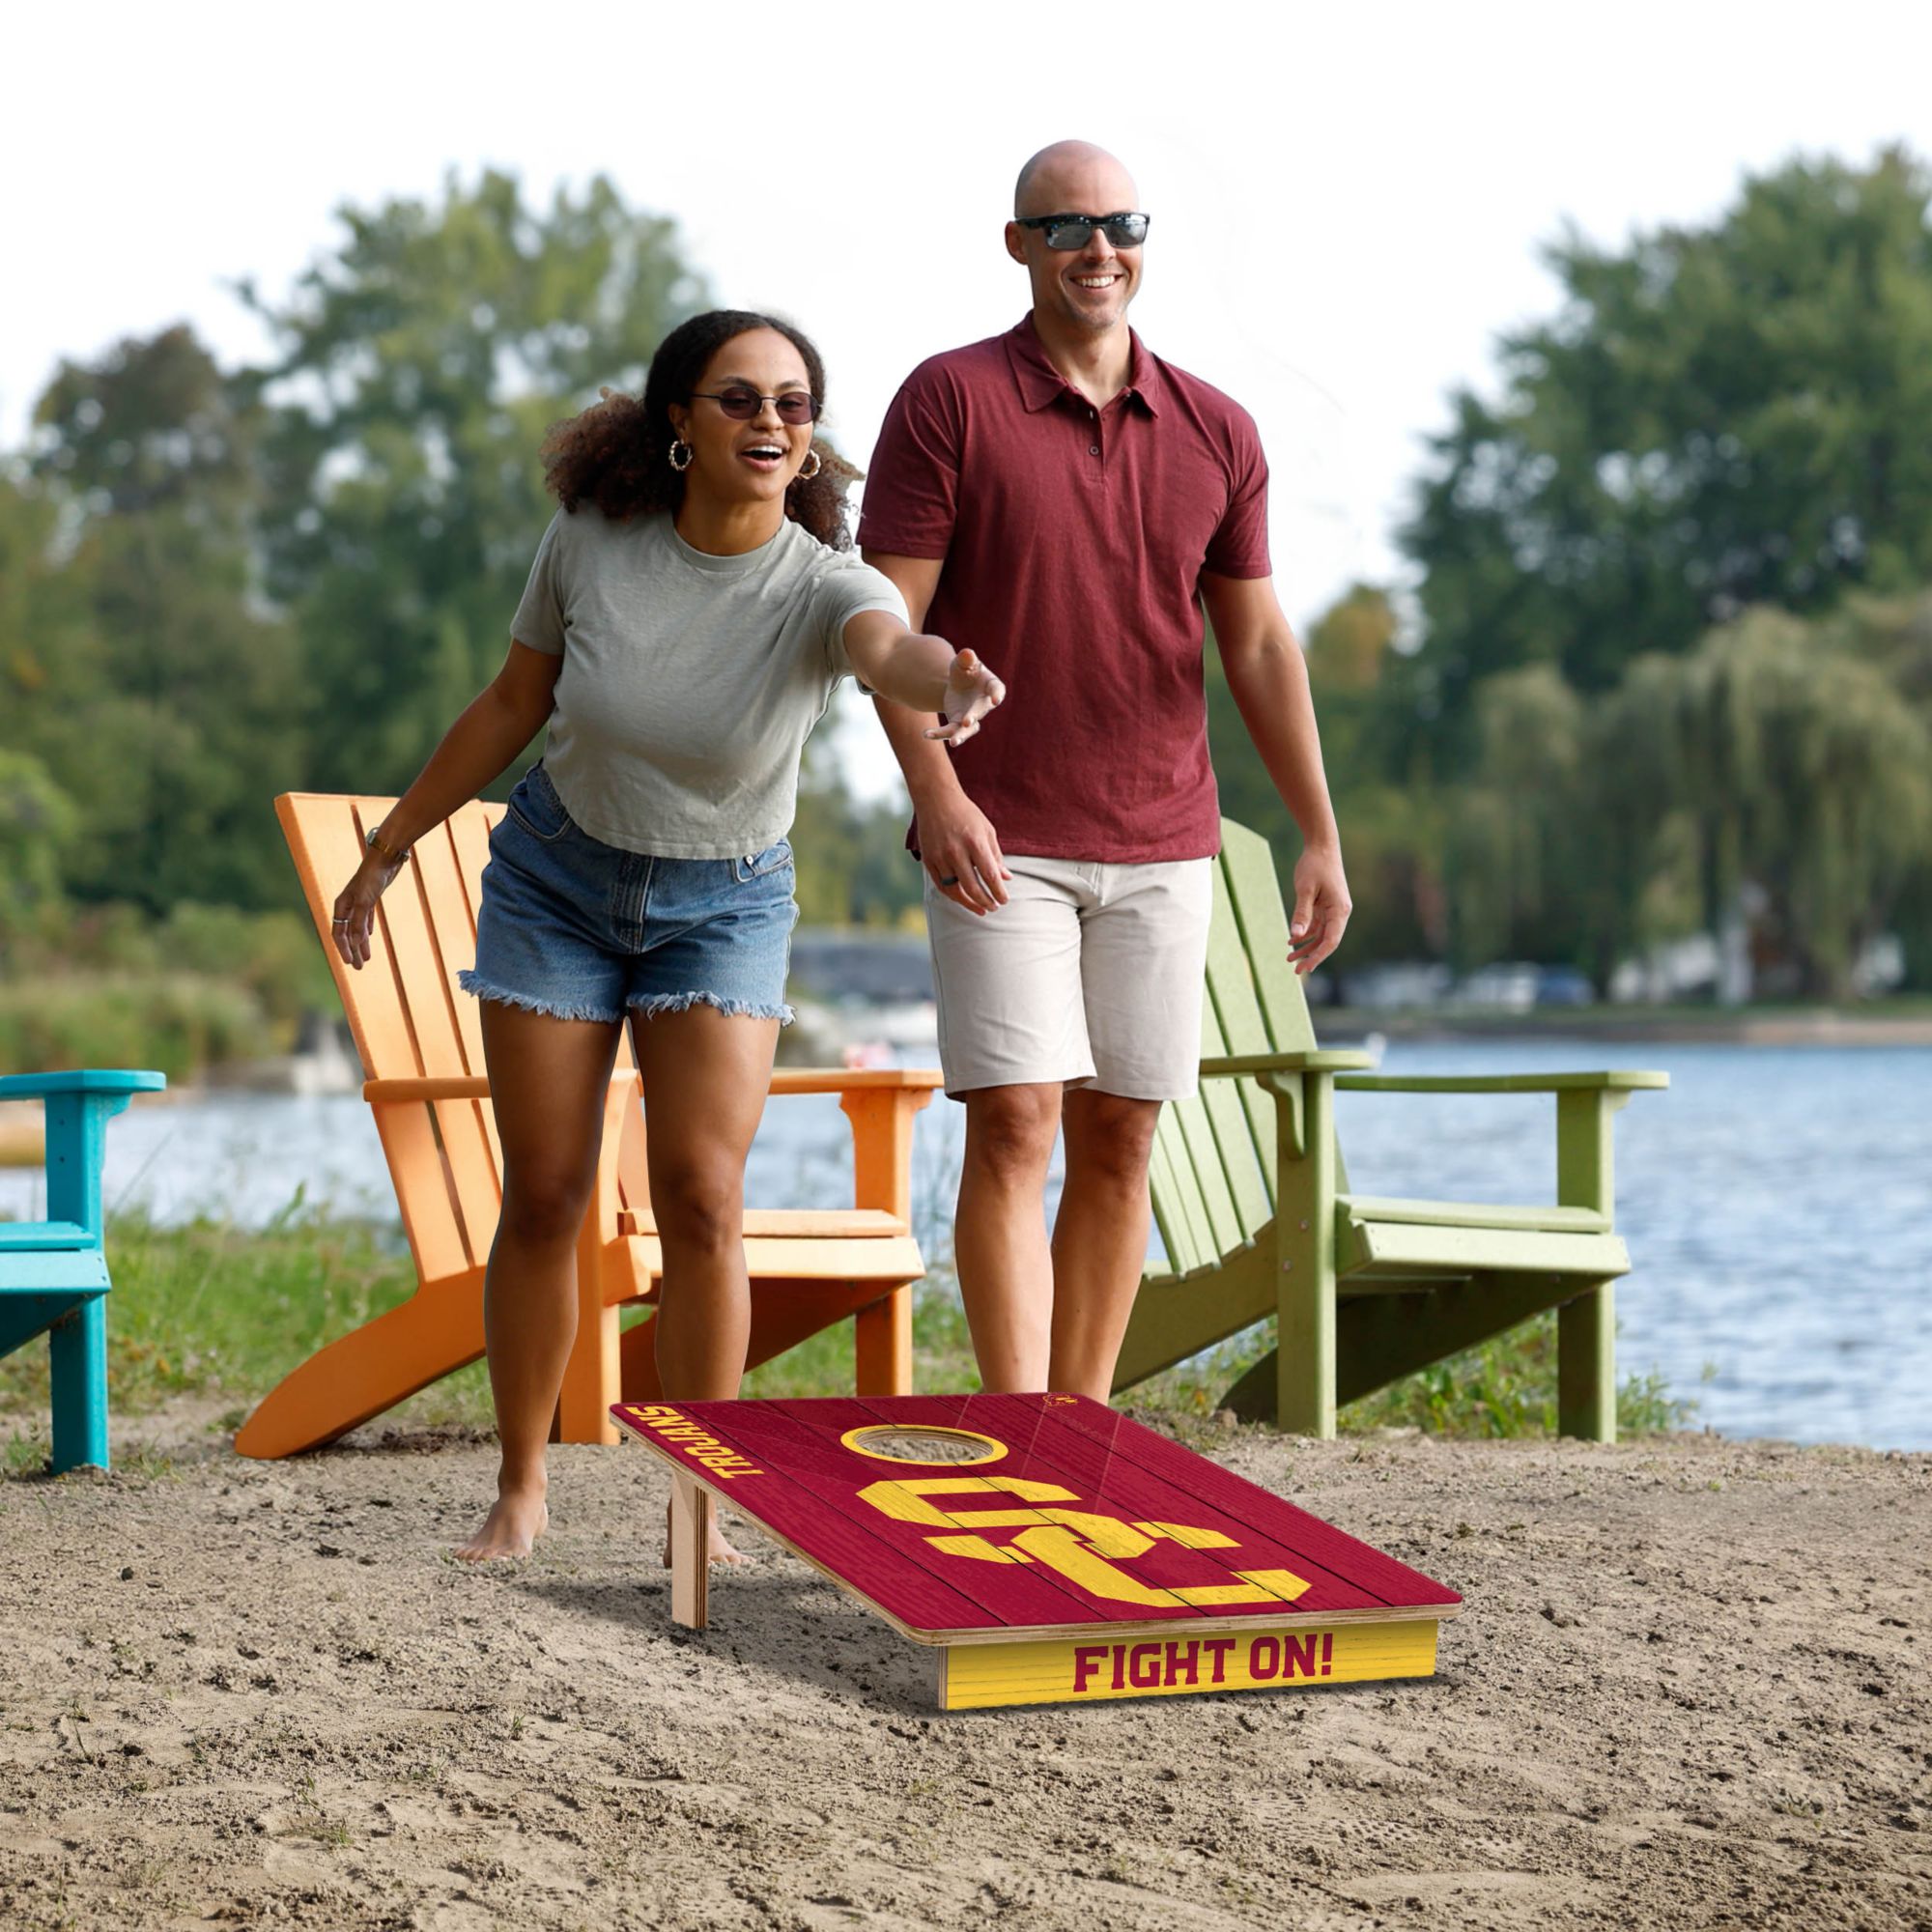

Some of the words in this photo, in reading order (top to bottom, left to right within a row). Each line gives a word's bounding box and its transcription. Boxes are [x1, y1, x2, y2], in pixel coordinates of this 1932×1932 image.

[624, 1406, 765, 1479] TROJANS
[1072, 1638, 1236, 1692] FIGHT
[1249, 1633, 1334, 1681] ON!
